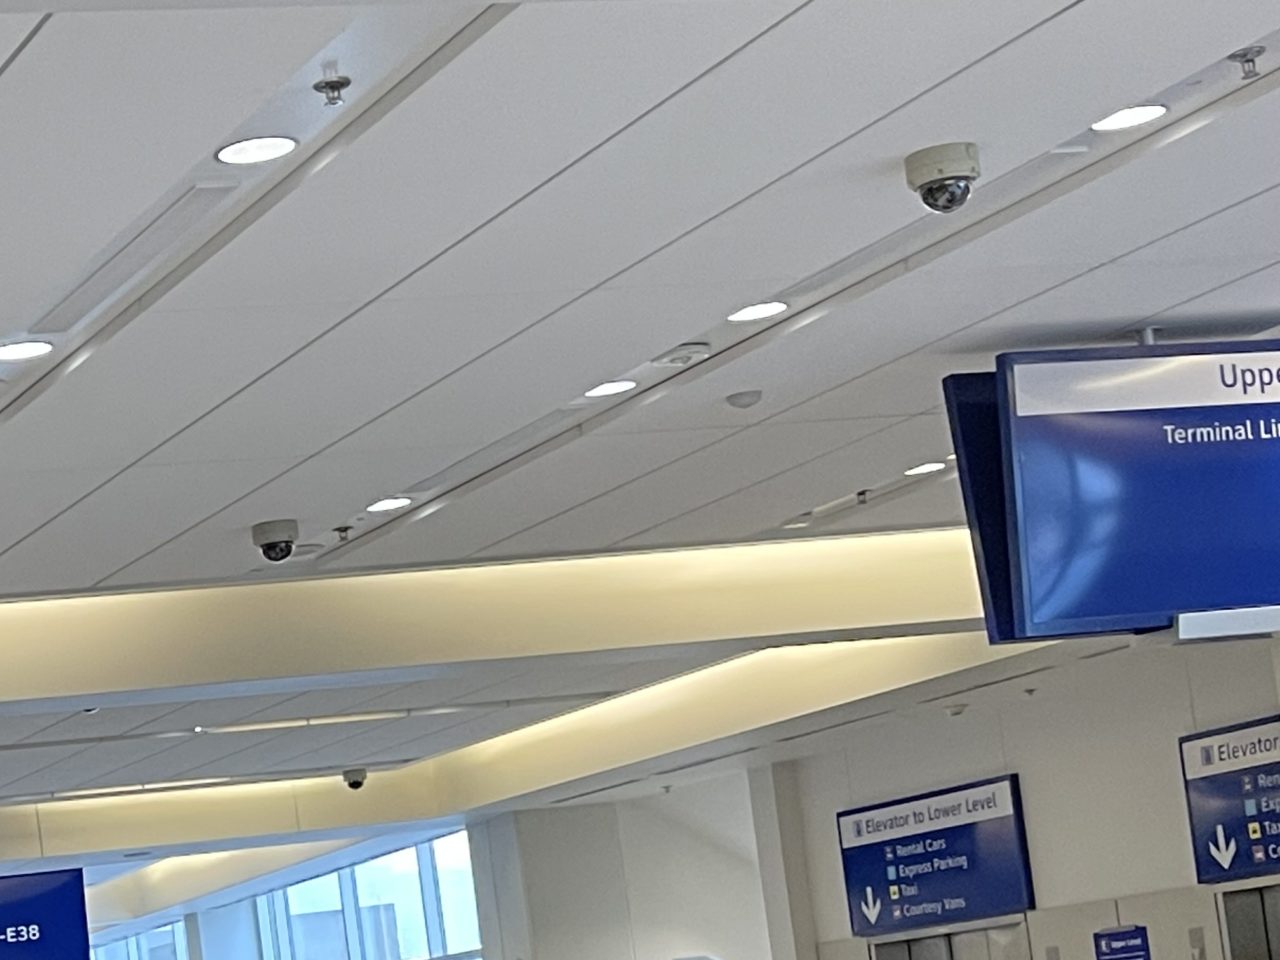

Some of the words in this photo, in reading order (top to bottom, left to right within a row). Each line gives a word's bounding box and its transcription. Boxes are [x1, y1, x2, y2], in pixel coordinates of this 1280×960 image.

[1219, 363, 1280, 395] Upp
[1163, 419, 1254, 444] Terminal
[1259, 418, 1280, 439] Li
[1218, 736, 1280, 762] Elevator
[865, 813, 909, 835] Elevator
[913, 811, 925, 825] to
[927, 802, 962, 822] Lower
[965, 791, 998, 814] Level
[896, 840, 926, 858] Rental
[925, 838, 947, 852] Cars
[899, 861, 932, 879] Express
[933, 855, 968, 872] Parking
[903, 901, 943, 917] Courtesy
[944, 897, 966, 910] Vans
